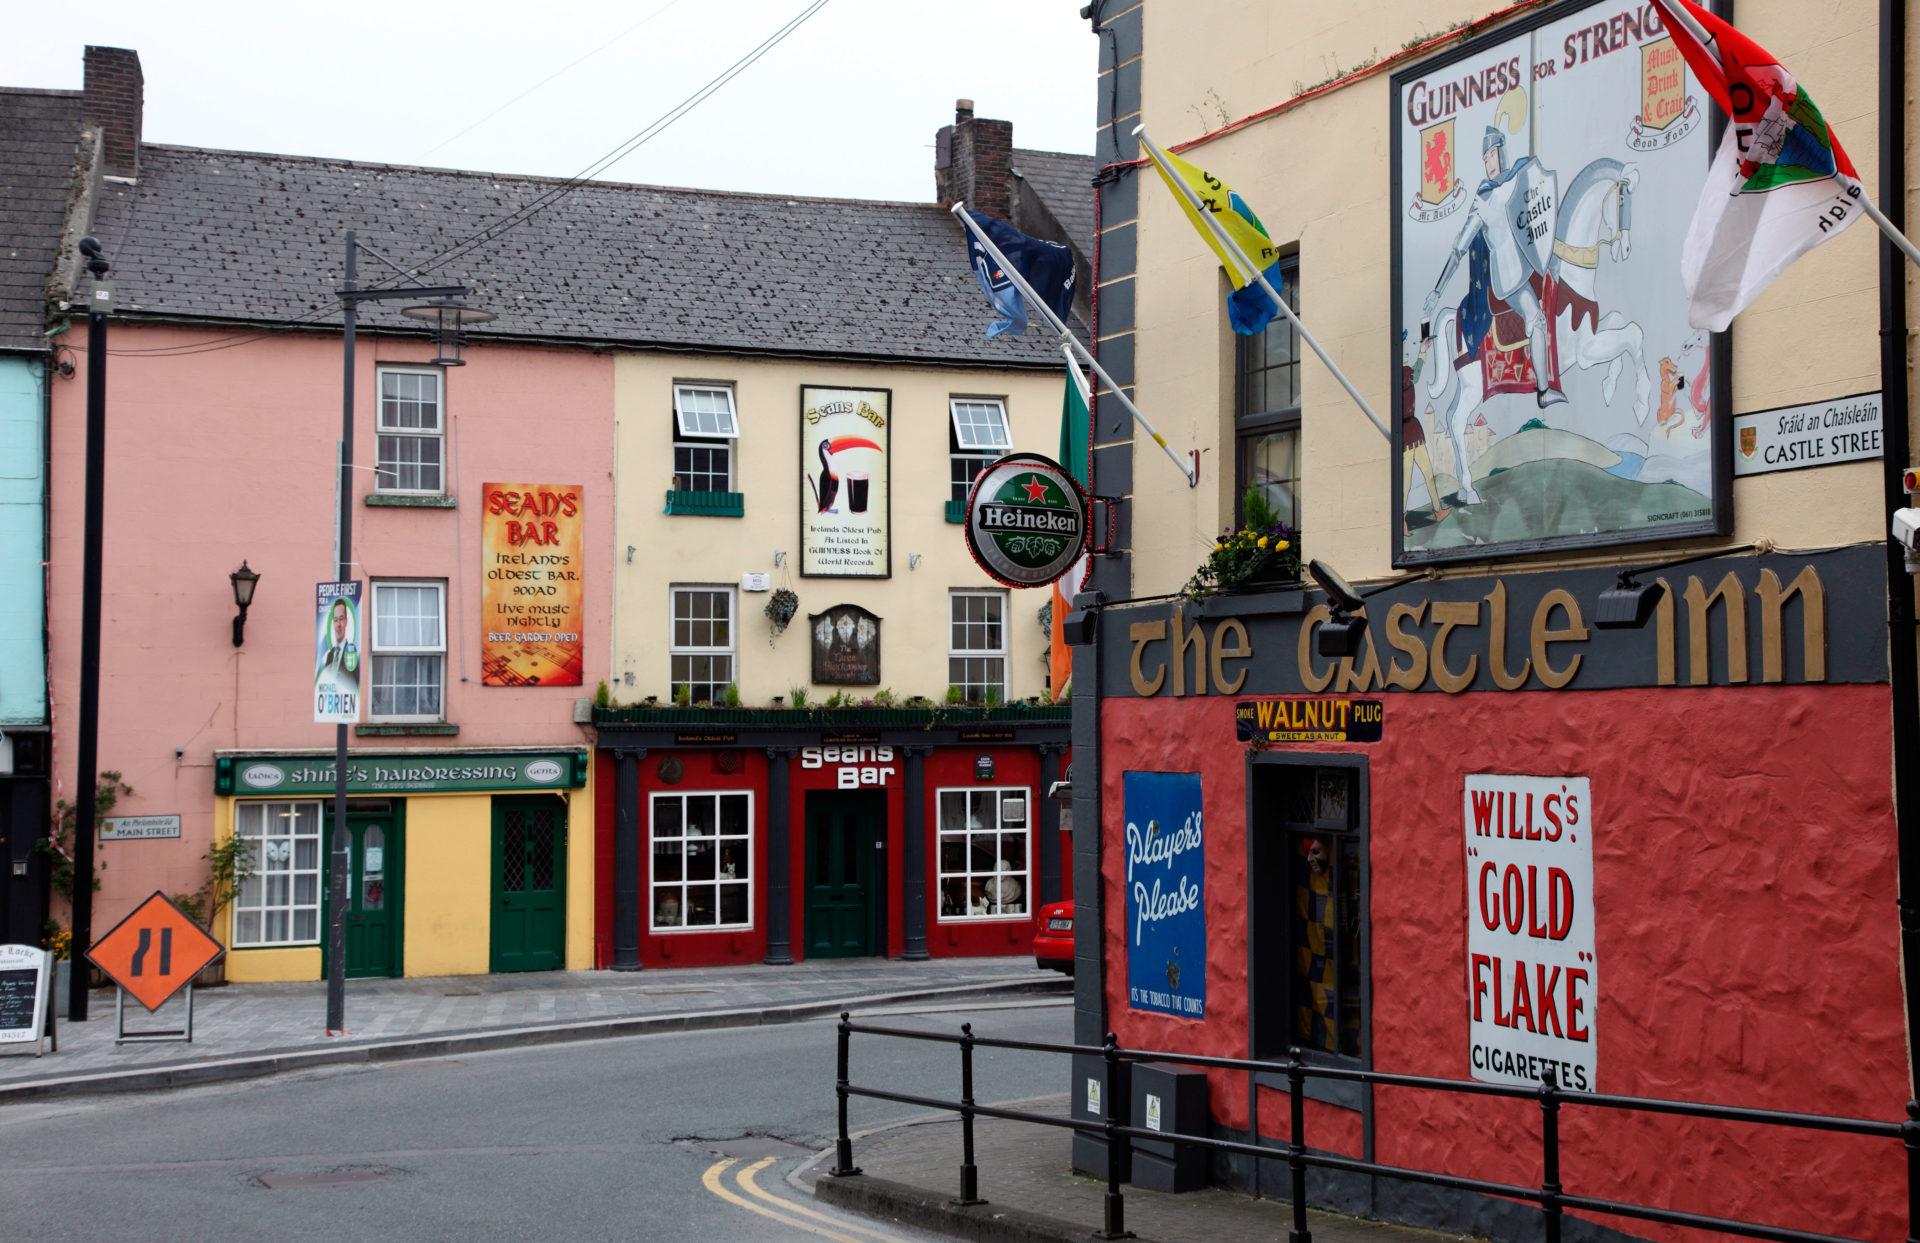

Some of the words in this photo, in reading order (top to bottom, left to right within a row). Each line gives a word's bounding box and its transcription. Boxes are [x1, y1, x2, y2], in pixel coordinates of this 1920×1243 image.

[1407, 56, 1520, 126] GUINNESS
[1532, 59, 1557, 82] FOR
[1647, 69, 1679, 97] Drink
[1523, 186, 1539, 204] The
[1517, 196, 1551, 230] Castle
[1526, 221, 1548, 246] Inn
[807, 401, 853, 425] Seans
[856, 400, 885, 428] Bar
[1777, 413, 1805, 436] Sráid
[1807, 415, 1820, 431] an
[1824, 402, 1878, 429] Chaisleáin
[1764, 438, 1824, 464] CASTLE
[1831, 429, 1883, 456] STREE
[984, 507, 1076, 532] Heineken
[505, 520, 560, 547] BAR
[318, 583, 340, 597] PEOPLE
[341, 582, 357, 596] FIRST
[317, 694, 356, 714] O'BRIEN
[1236, 708, 1254, 719] SMOKE
[1256, 699, 1351, 729] WALNUT
[1355, 704, 1381, 723] PLUG
[1275, 732, 1301, 740] SWEET
[1304, 732, 1315, 740] AS
[1317, 732, 1323, 740] A
[1325, 732, 1340, 740] NUT
[801, 746, 894, 769] Seans
[837, 767, 895, 790] Bar
[146, 827, 177, 835] STREET
[1126, 811, 1202, 883] Player's
[1134, 875, 1199, 946] Please
[1140, 989, 1149, 1004] THE
[1149, 990, 1171, 1008] TOBACCO
[1171, 994, 1182, 1011] THAT
[1183, 996, 1203, 1014] COUNTS
